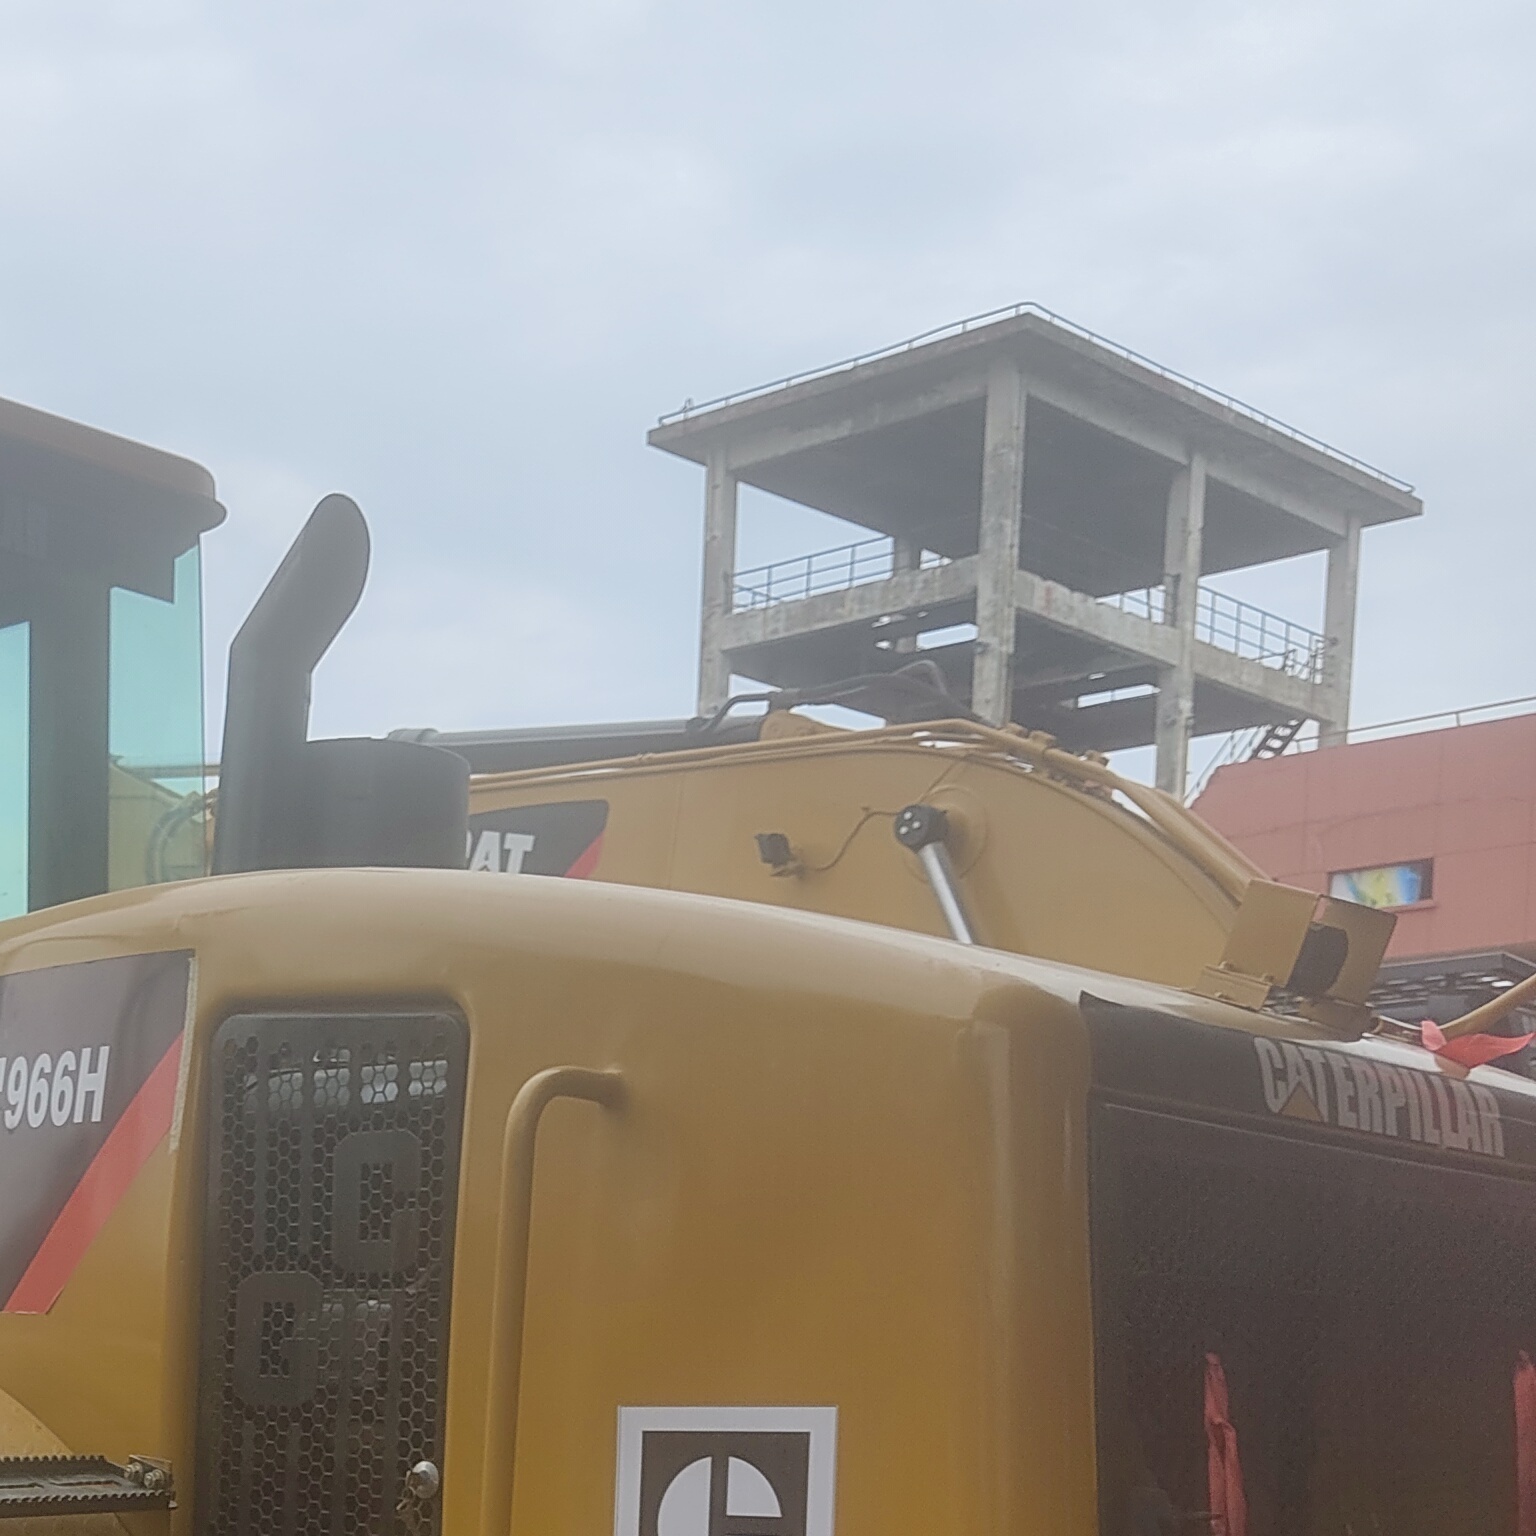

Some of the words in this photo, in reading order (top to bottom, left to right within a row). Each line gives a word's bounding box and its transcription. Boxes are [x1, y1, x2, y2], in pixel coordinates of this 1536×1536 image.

[466, 831, 535, 875] AT
[5, 1045, 110, 1130] 966H
[1254, 1036, 1505, 1158] CATERPILLAR
